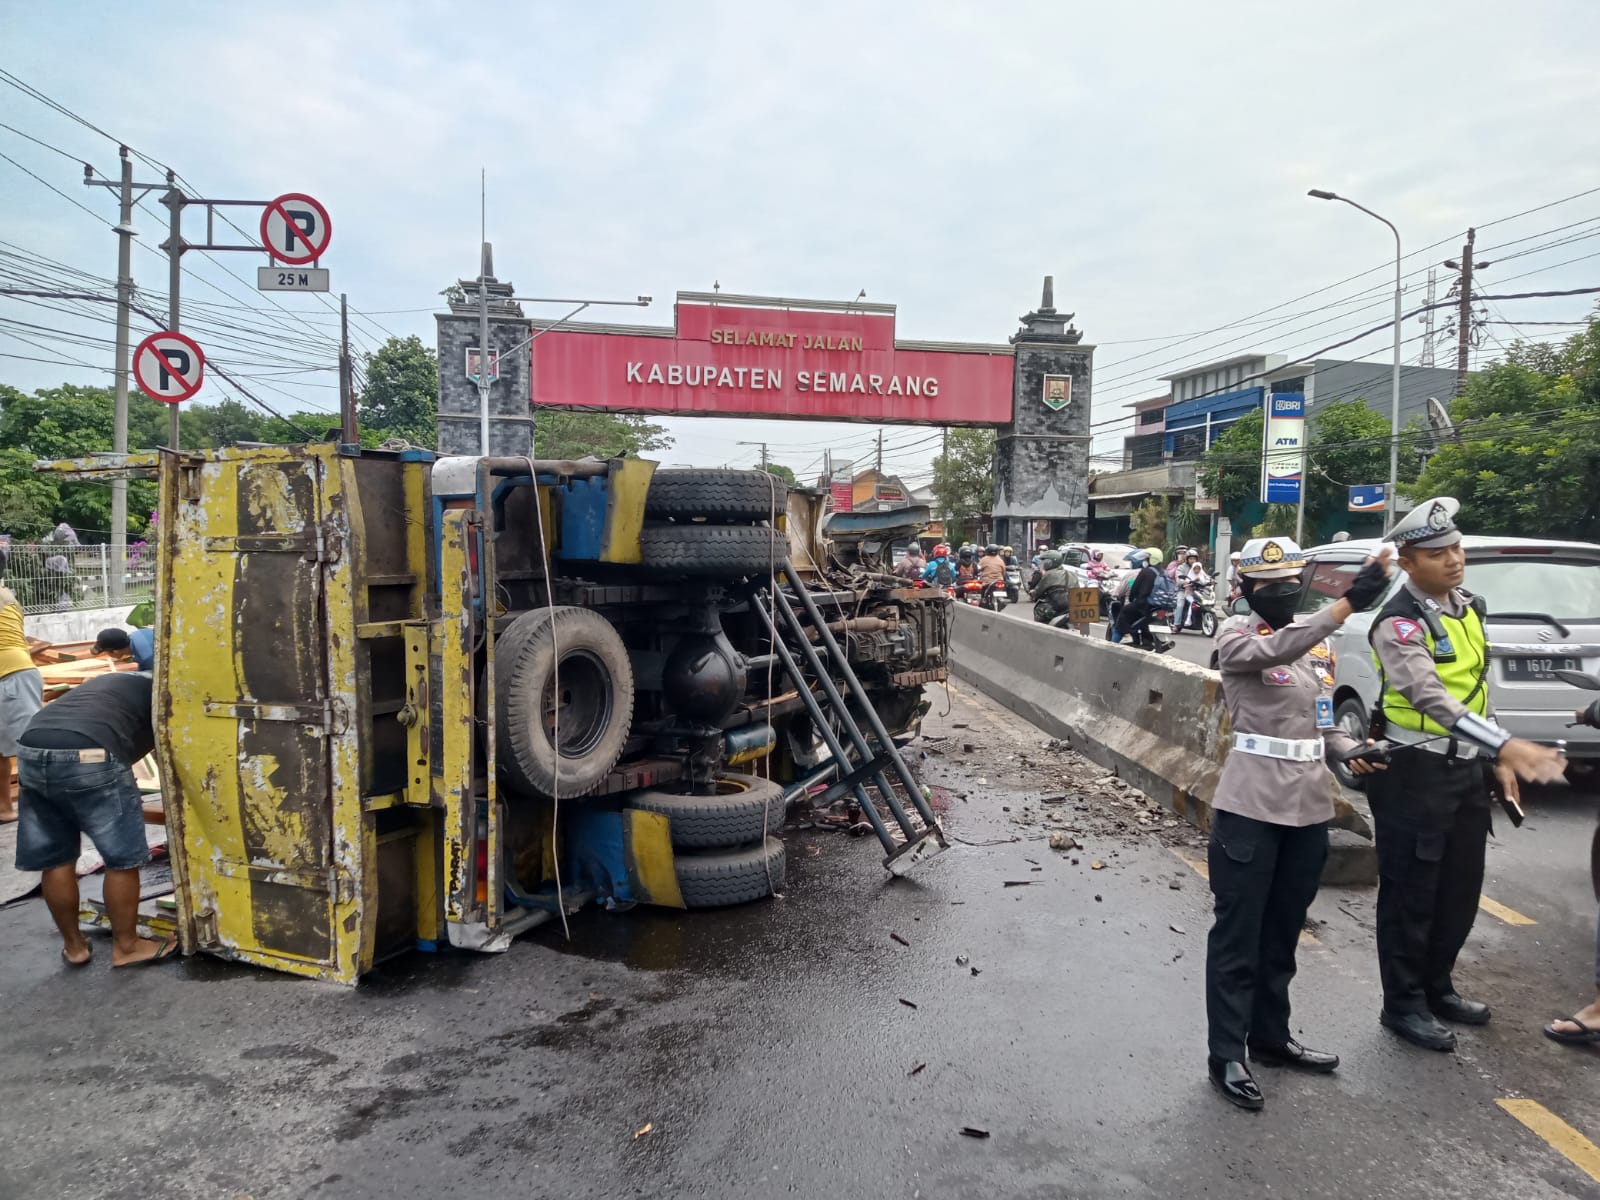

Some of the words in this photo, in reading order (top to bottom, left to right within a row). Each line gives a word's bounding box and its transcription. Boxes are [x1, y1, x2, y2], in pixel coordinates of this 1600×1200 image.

[285, 211, 315, 251] P
[278, 273, 295, 286] 25
[299, 274, 309, 286] M
[710, 328, 797, 348] SELAMAT
[803, 336, 863, 352] JALAN
[159, 349, 190, 390] P
[626, 361, 783, 389] KABUPATEN
[797, 372, 940, 397] SEMARANG
[1285, 401, 1301, 410] BRI
[1276, 438, 1298, 446] ATM
[1076, 591, 1092, 602] 17
[1507, 659, 1517, 672] H
[1527, 659, 1553, 672] 1612
